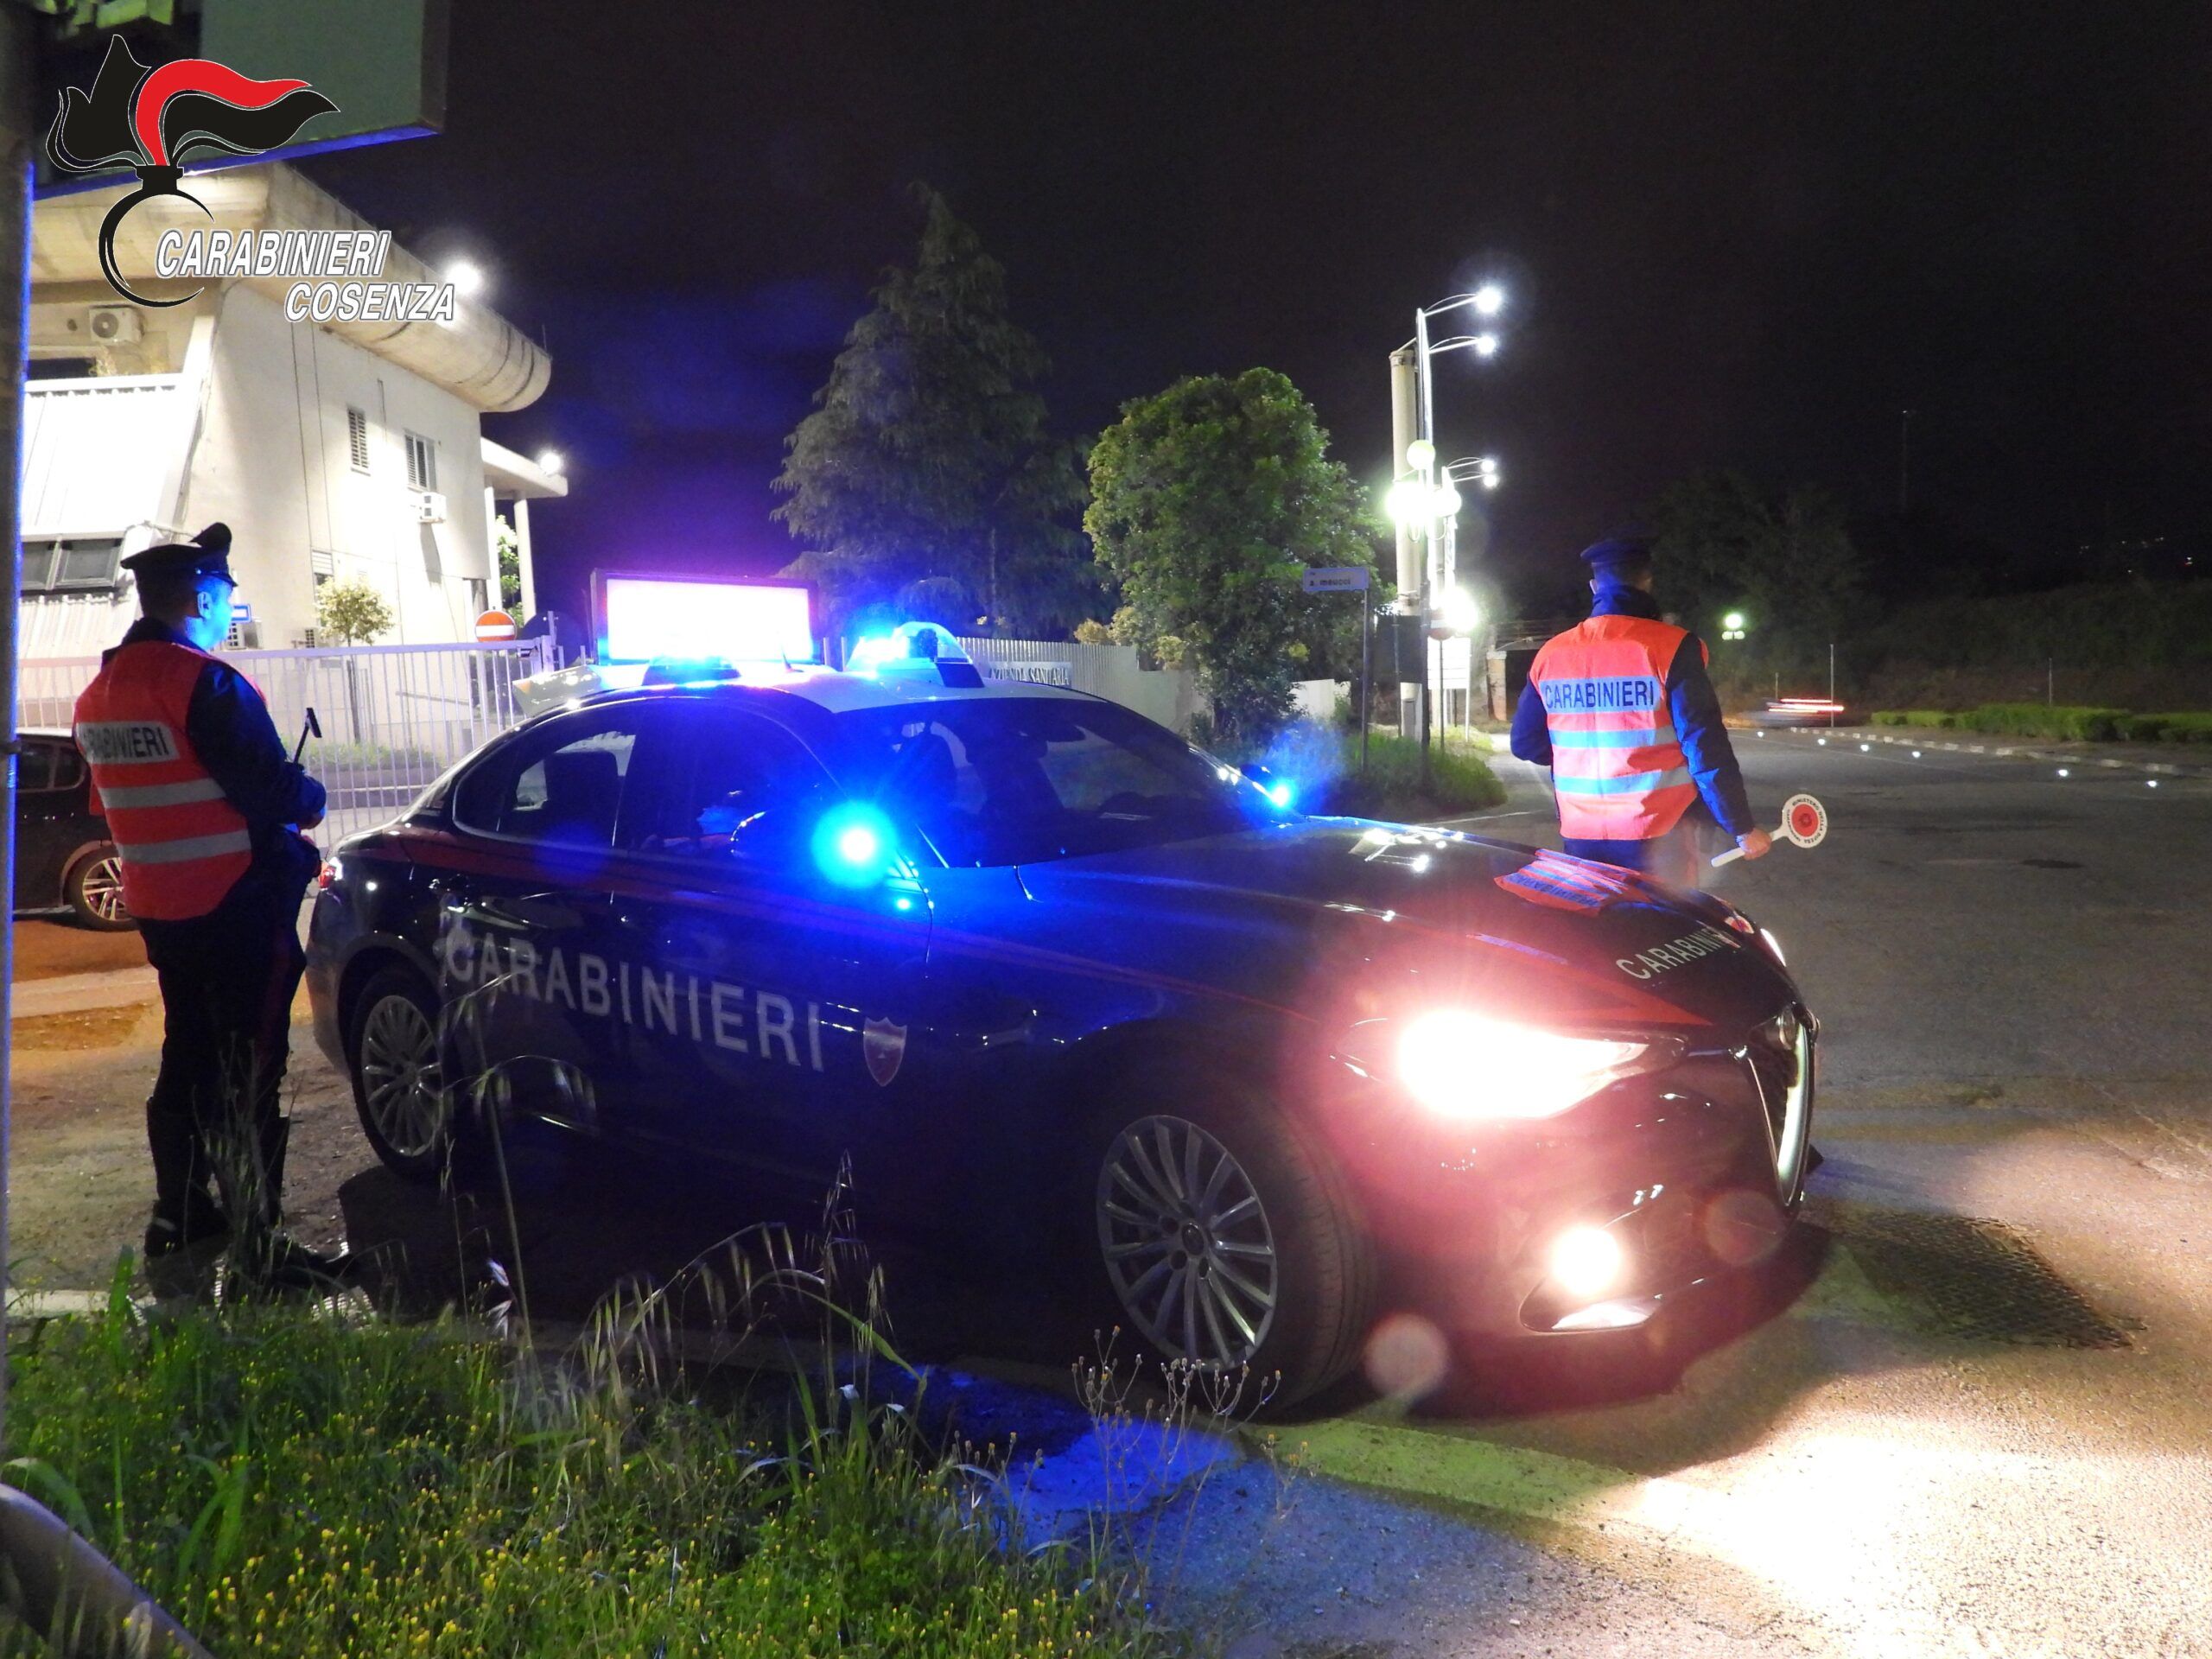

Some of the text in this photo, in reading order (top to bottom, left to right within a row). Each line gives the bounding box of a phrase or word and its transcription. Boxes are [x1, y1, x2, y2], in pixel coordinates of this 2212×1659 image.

[989, 668, 1070, 685] AZIENDA SANITARIA
[1545, 681, 1654, 709] CARABINIERI
[83, 727, 169, 759] ARABINIERI
[1616, 927, 1732, 979] CARABINI
[444, 926, 824, 1071] CARABINIERI
